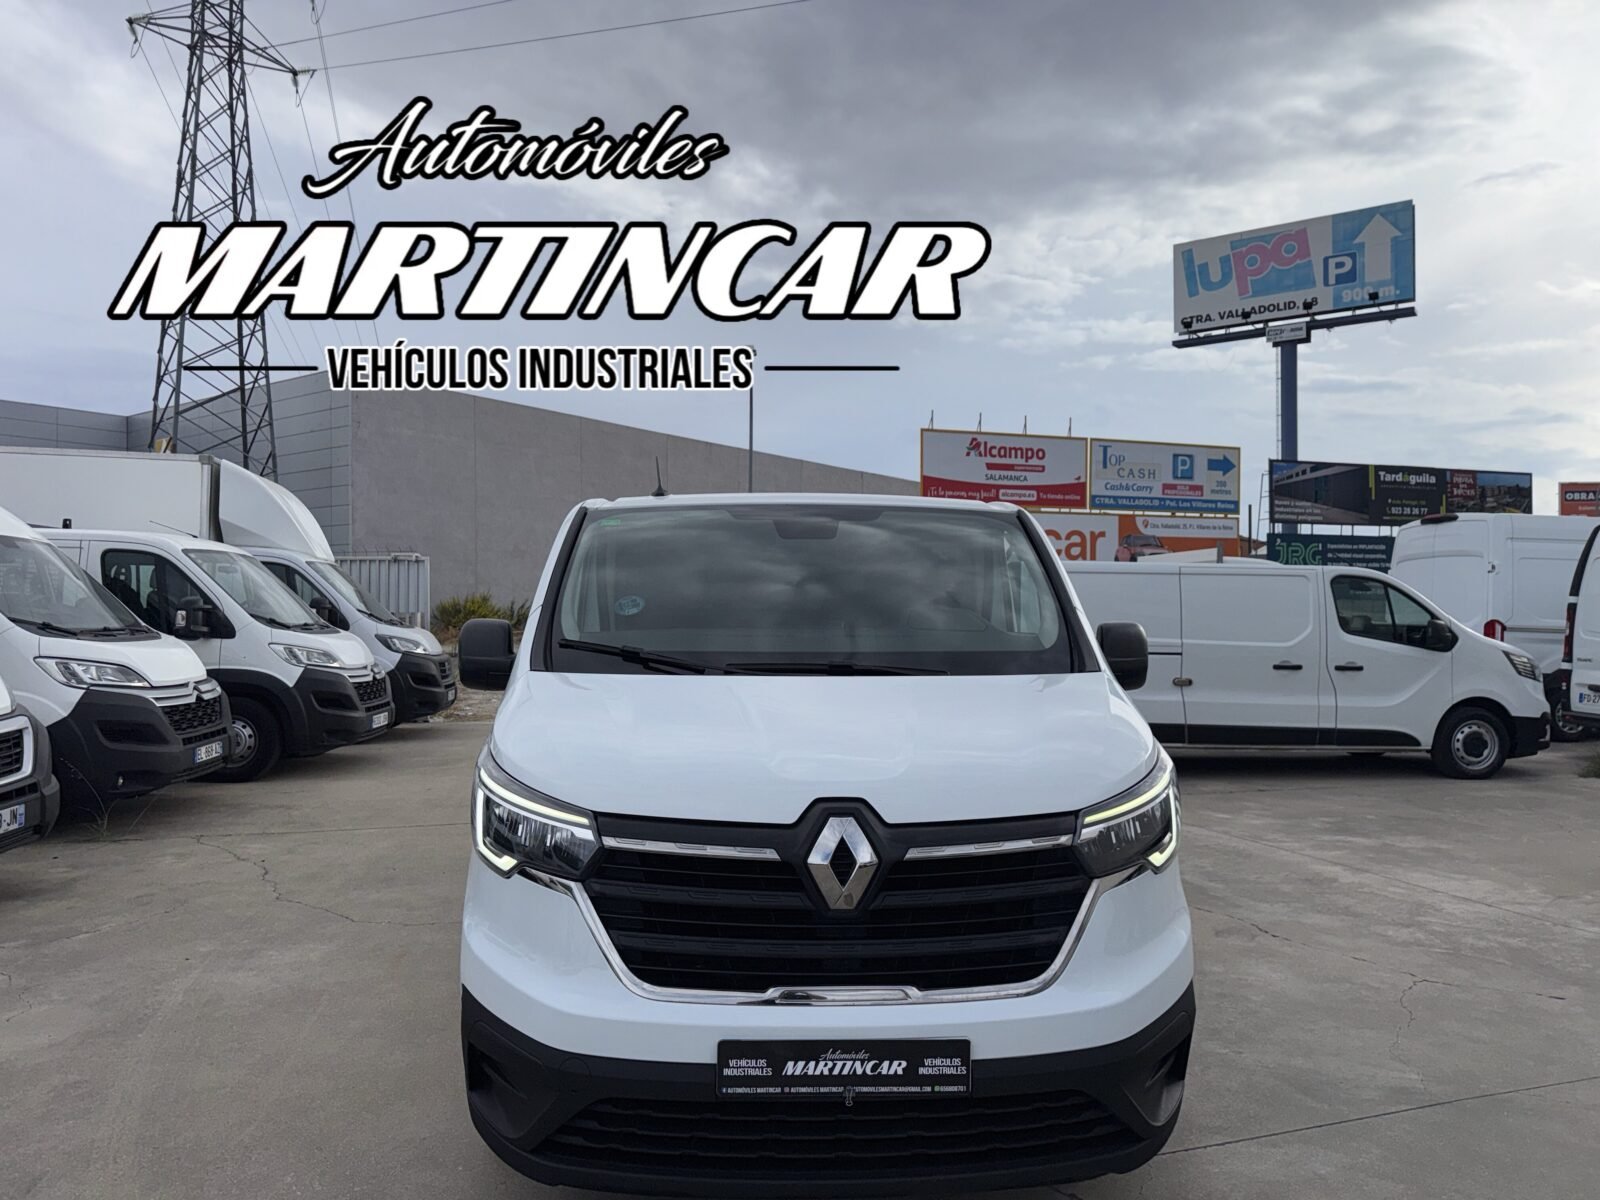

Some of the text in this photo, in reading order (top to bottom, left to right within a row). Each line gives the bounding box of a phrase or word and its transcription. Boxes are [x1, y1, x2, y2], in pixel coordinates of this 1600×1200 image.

[1181, 227, 1311, 298] lupa
[1328, 256, 1352, 285] P
[1303, 297, 1319, 309] 8
[965, 437, 1046, 462] Alcampo
[1177, 456, 1190, 477] P
[985, 473, 1028, 482] SALAMANCA
[1117, 468, 1156, 479] CASH
[1378, 471, 1436, 485] Tardáguila
[1104, 482, 1154, 494] Cash&Carry
[1001, 490, 1035, 499] alcampo.es
[1566, 492, 1595, 501] OBRA
[1095, 497, 1115, 505] CTRA.
[1118, 498, 1159, 506] VALLADOLID
[819, 1048, 870, 1060] Automóviles
[728, 1058, 767, 1067] VEHÍCULOS
[924, 1057, 961, 1066] VEHÍCULOS
[723, 1067, 772, 1076] INDUSTRIALES
[782, 1060, 907, 1075] MARTINCAR
[918, 1066, 967, 1075] INDUSTRIALES
